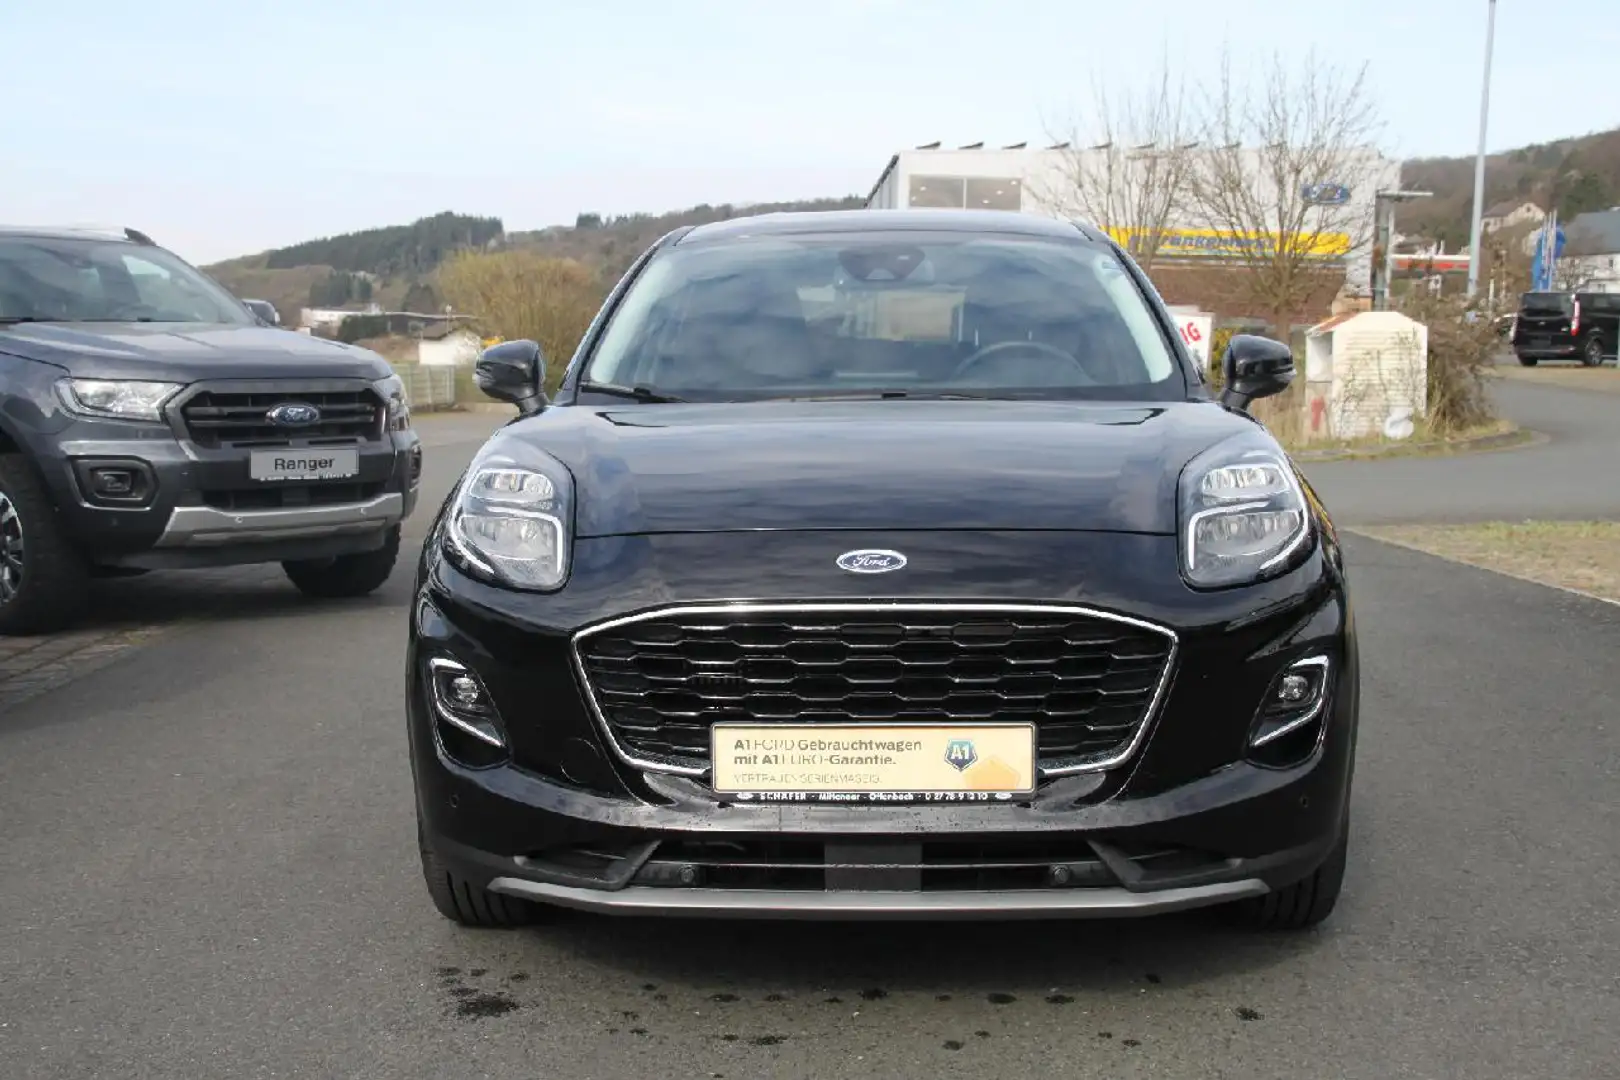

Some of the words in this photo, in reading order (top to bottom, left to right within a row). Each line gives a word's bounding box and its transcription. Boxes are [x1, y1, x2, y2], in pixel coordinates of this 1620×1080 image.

[273, 457, 335, 472] Ranger
[852, 553, 891, 567] Ford
[734, 739, 750, 750] A1
[798, 739, 922, 752] Gebrauchtwagen
[951, 744, 969, 760] A1
[734, 754, 758, 765] mit
[762, 754, 778, 765] A1
